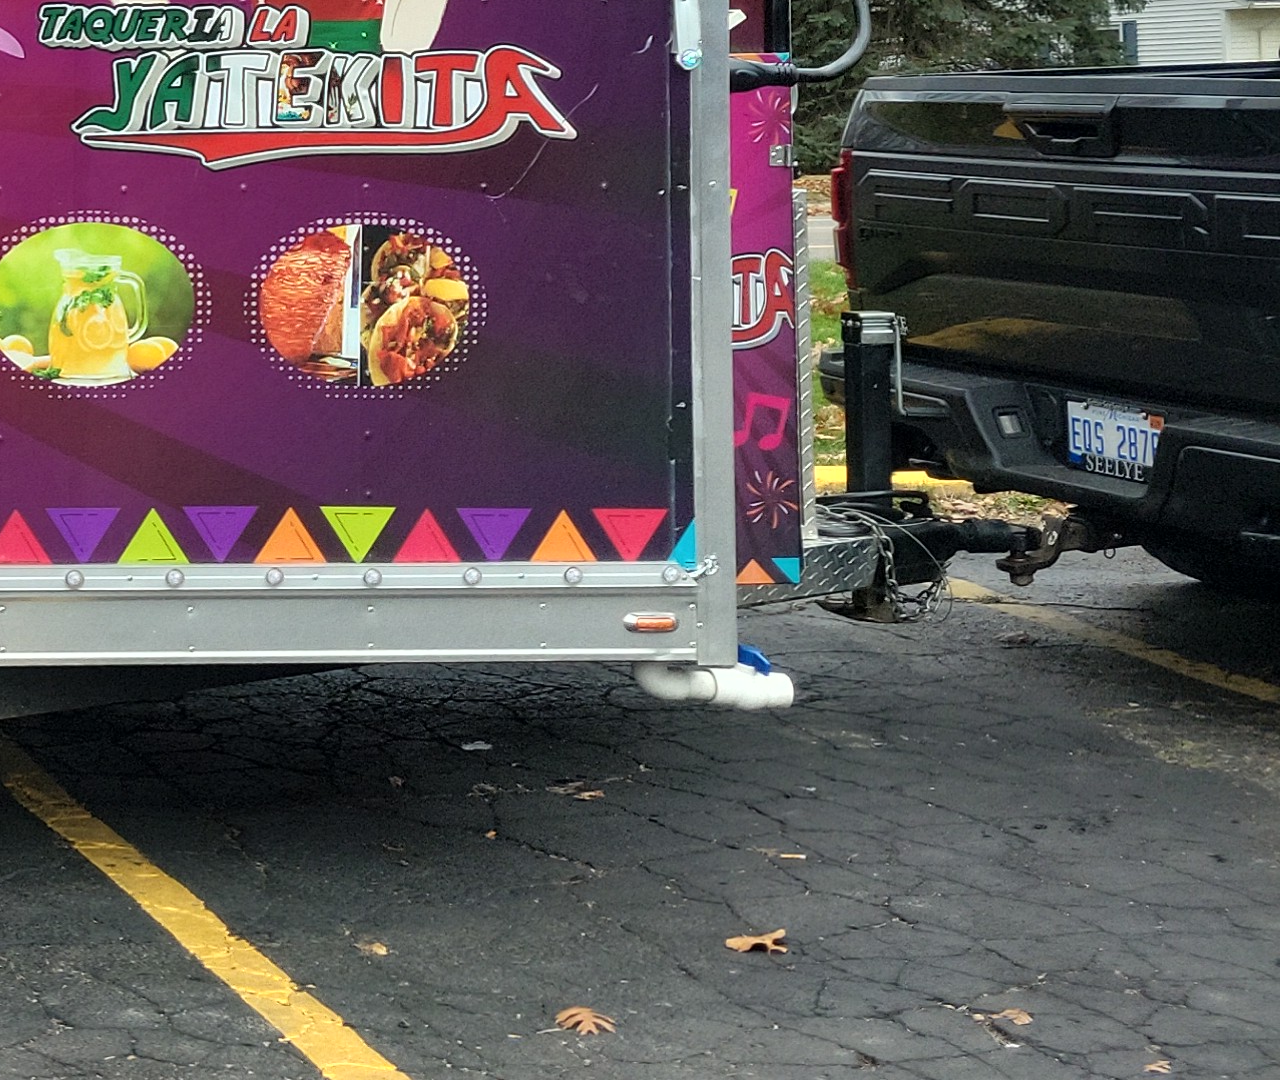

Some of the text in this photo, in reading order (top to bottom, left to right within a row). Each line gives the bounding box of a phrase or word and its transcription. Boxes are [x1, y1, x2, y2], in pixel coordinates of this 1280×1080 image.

[40, 6, 300, 44] TAQUERIA LA
[77, 47, 577, 138] YATEKITA
[1085, 454, 1145, 482] SEELYE
